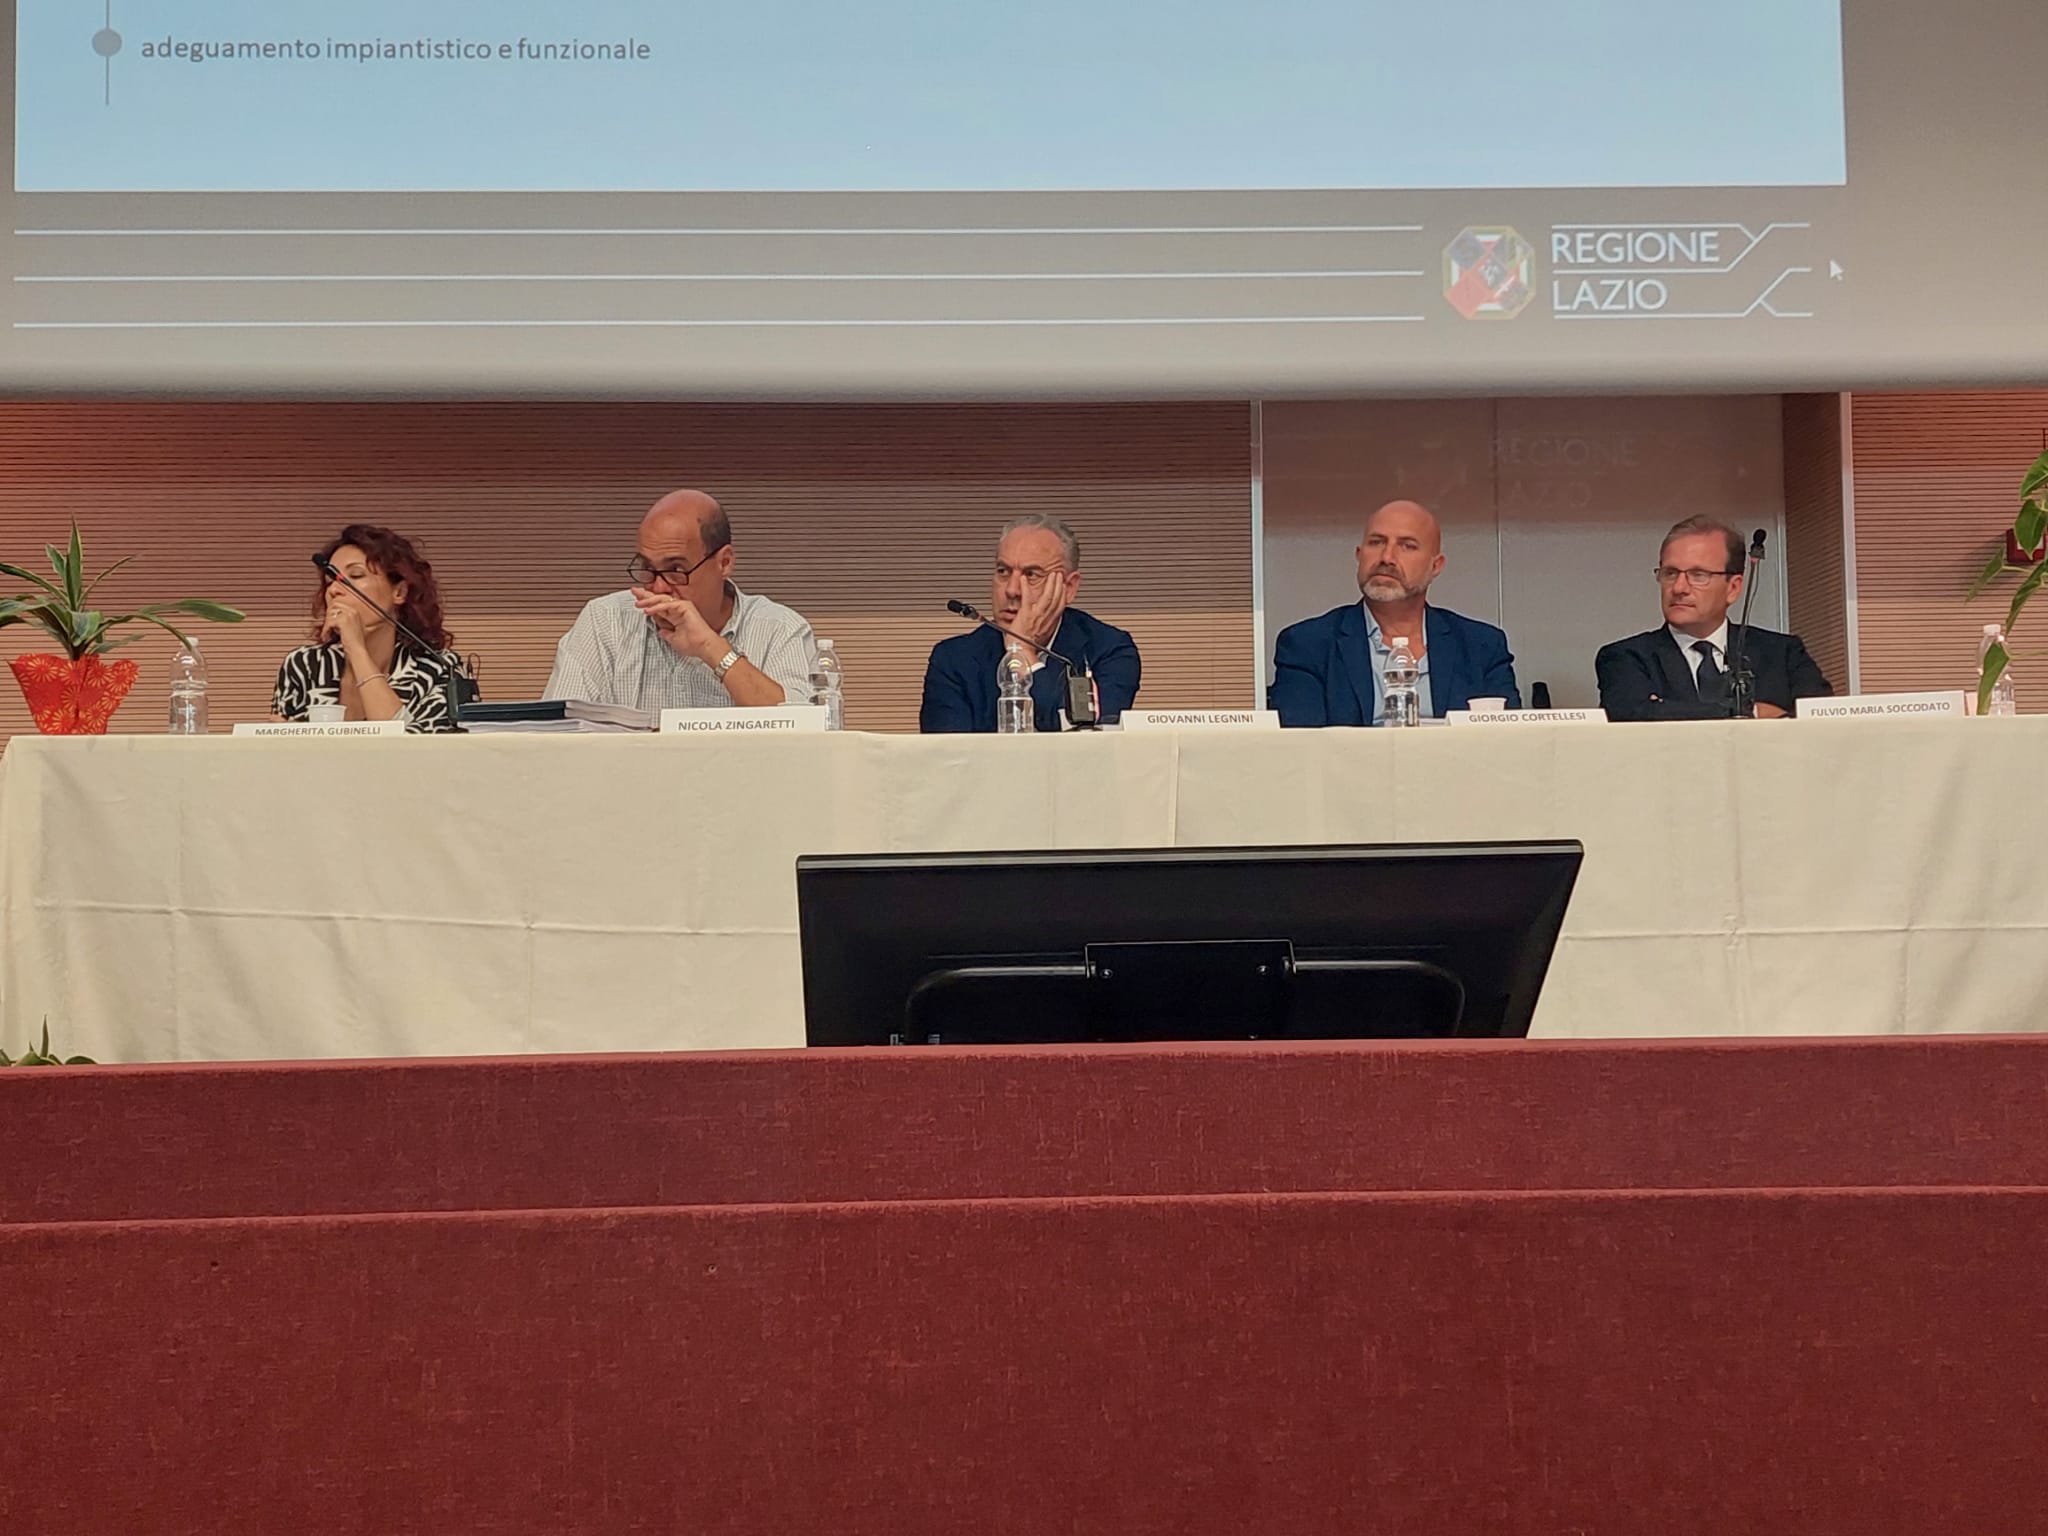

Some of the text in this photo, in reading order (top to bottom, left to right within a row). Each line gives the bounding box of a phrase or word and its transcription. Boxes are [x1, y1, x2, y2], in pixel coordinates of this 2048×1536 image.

[141, 37, 651, 62] adeguamento impiantistico e funzionale
[1551, 231, 1720, 264] REGIONE
[1553, 278, 1668, 311] LAZIO
[1811, 702, 1951, 716] FULVIO MARIA SOCCODATO
[1147, 714, 1254, 724] GIOVANNI LEGNINI
[1469, 712, 1586, 723] GIORGIO CORTELLESI
[255, 727, 381, 736] MARGHERITA GUBINELLI
[678, 719, 795, 731] NICOLA ZINGARETTI
